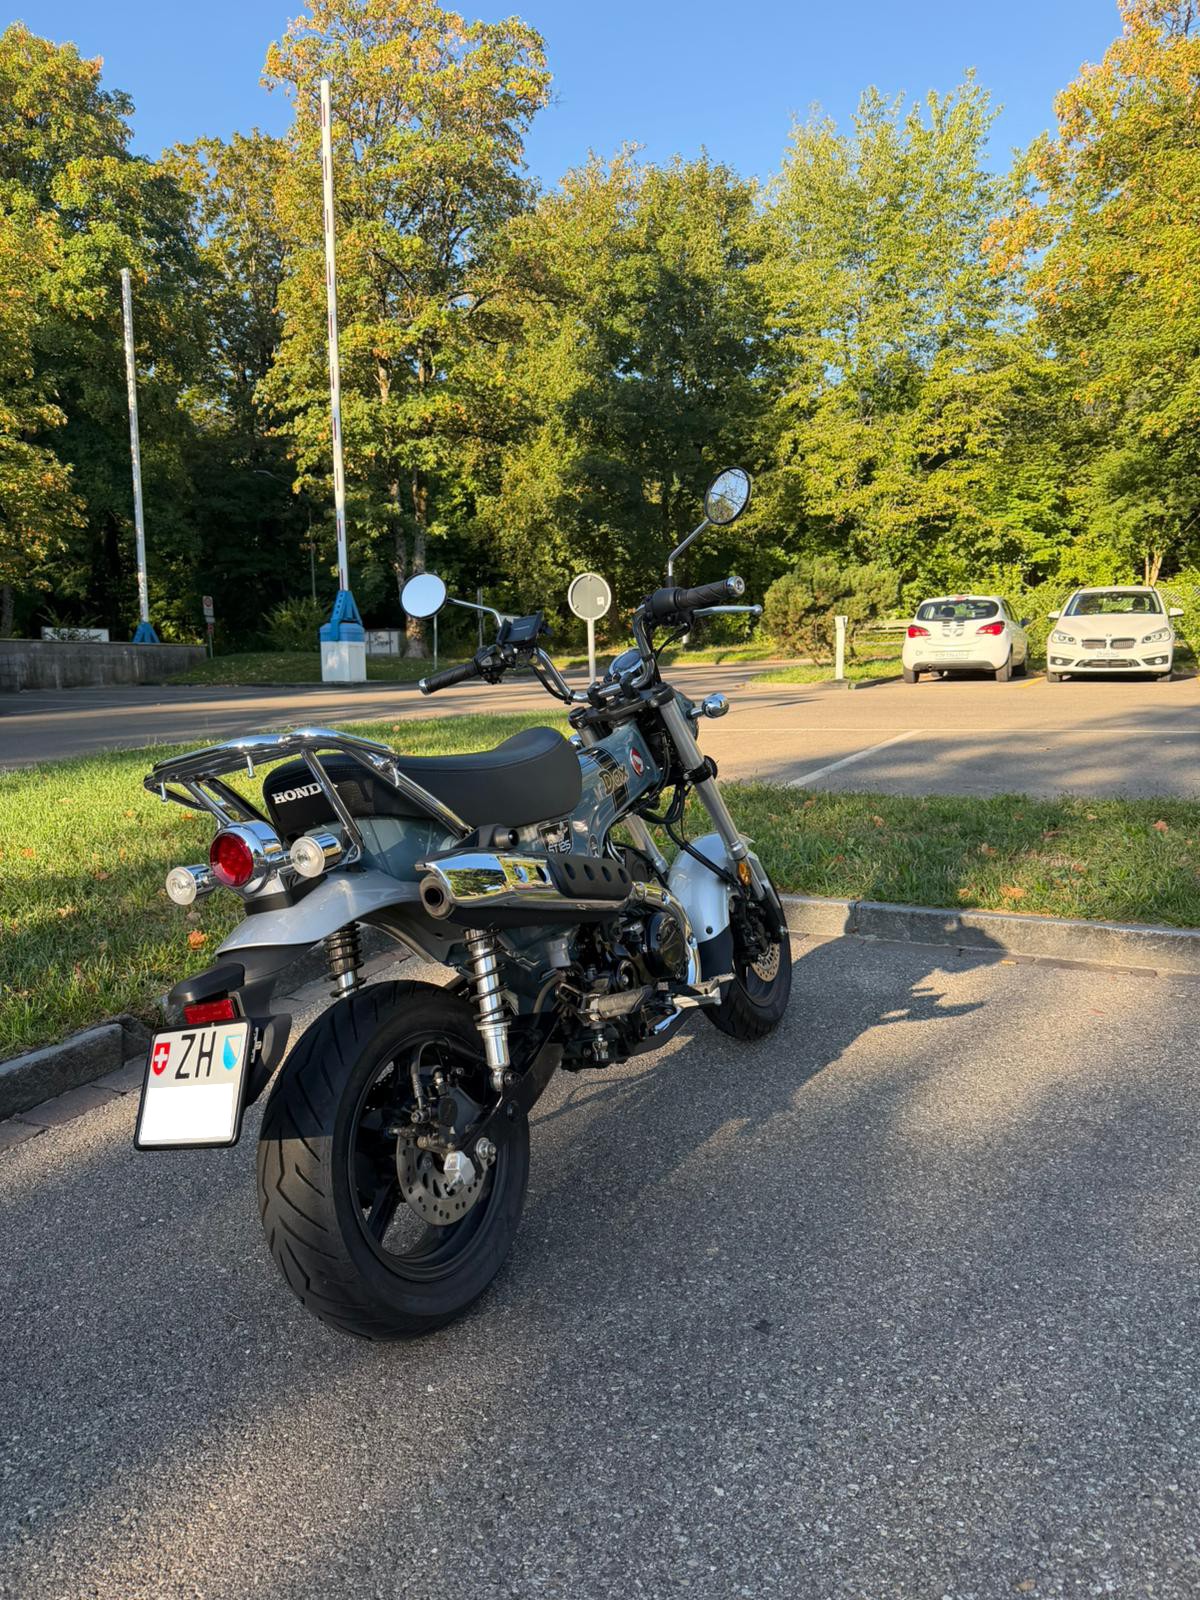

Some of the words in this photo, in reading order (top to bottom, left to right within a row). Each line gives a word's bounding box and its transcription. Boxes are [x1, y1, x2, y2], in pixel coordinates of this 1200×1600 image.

[271, 782, 339, 804] HOND
[598, 763, 629, 796] Dax
[174, 1031, 217, 1080] ZH
